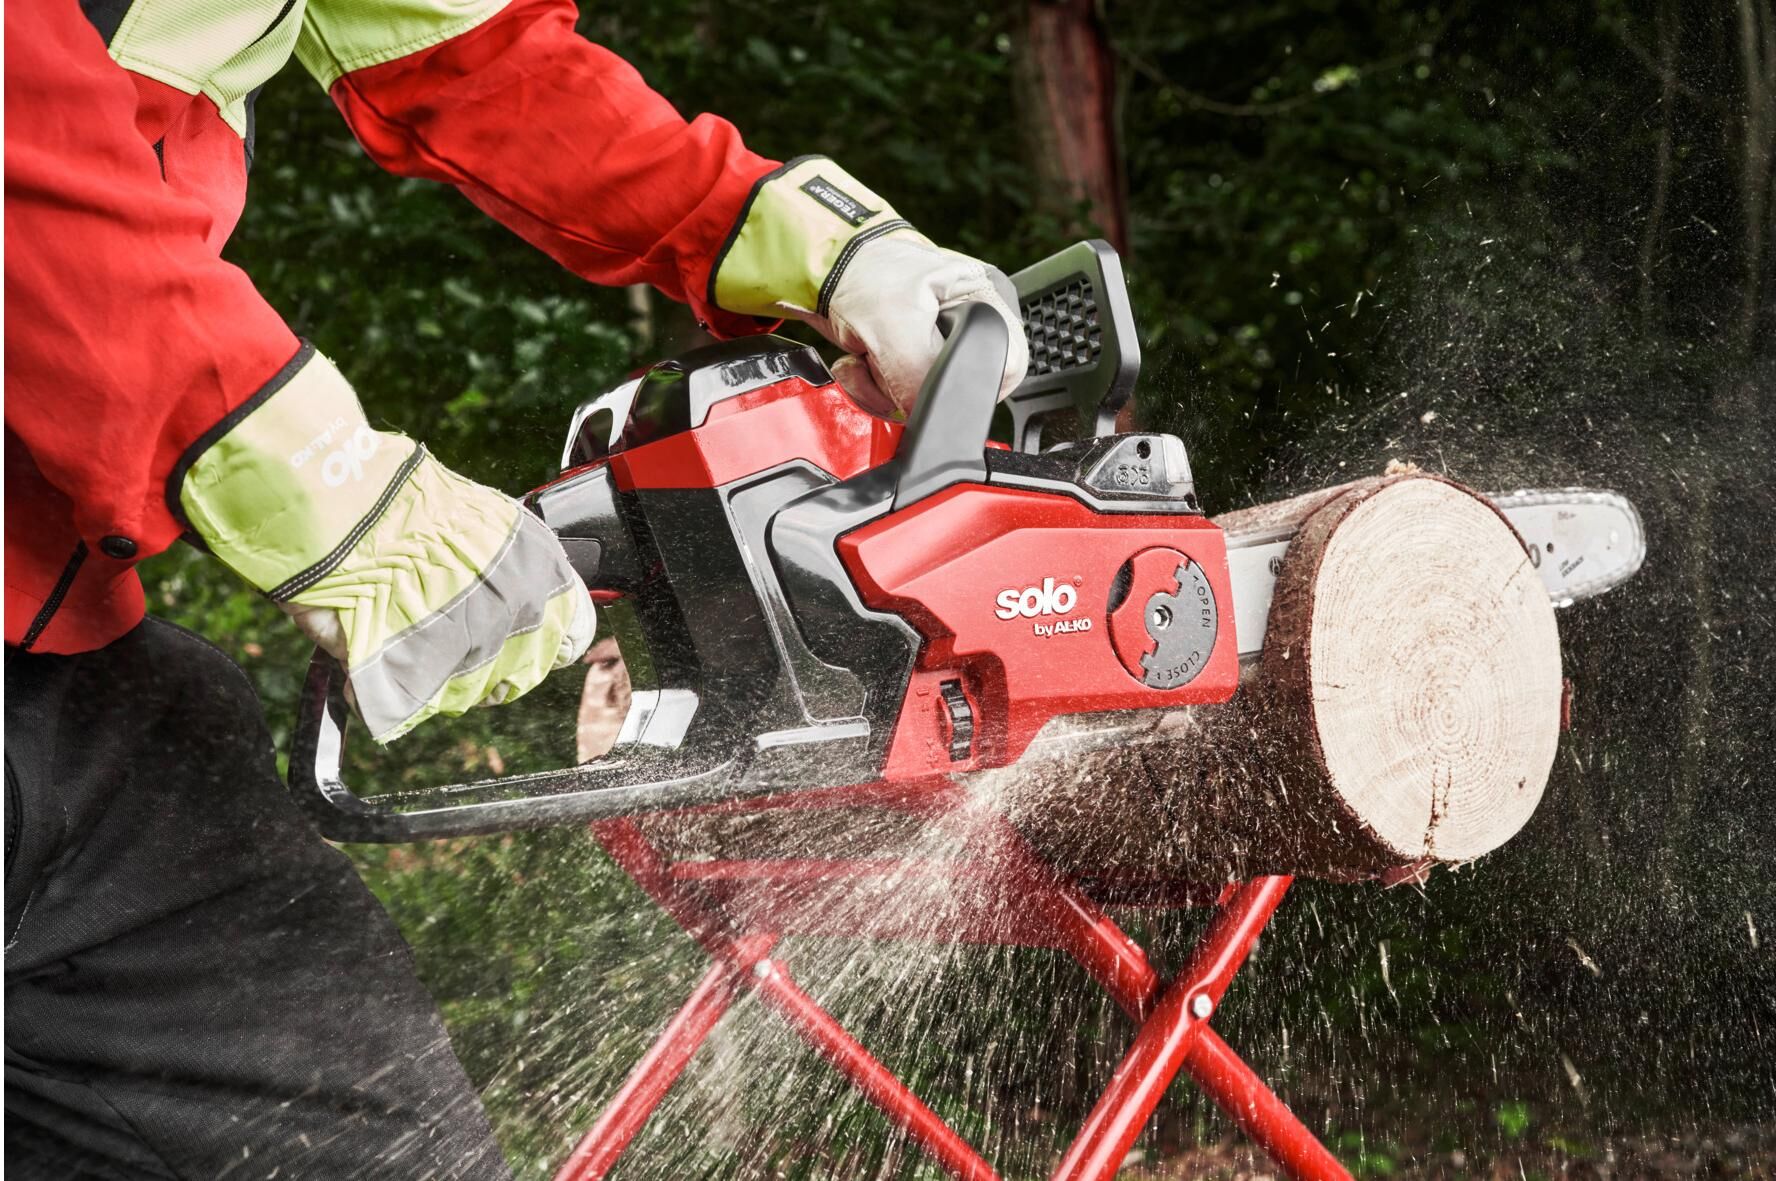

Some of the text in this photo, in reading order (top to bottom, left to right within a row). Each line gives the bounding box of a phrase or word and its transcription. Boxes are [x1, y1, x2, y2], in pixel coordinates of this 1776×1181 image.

[321, 424, 382, 488] olo
[994, 577, 1077, 619] solo
[1197, 585, 1211, 628] OPEN
[1034, 623, 1053, 637] by
[1167, 651, 1200, 680] CLOSE
